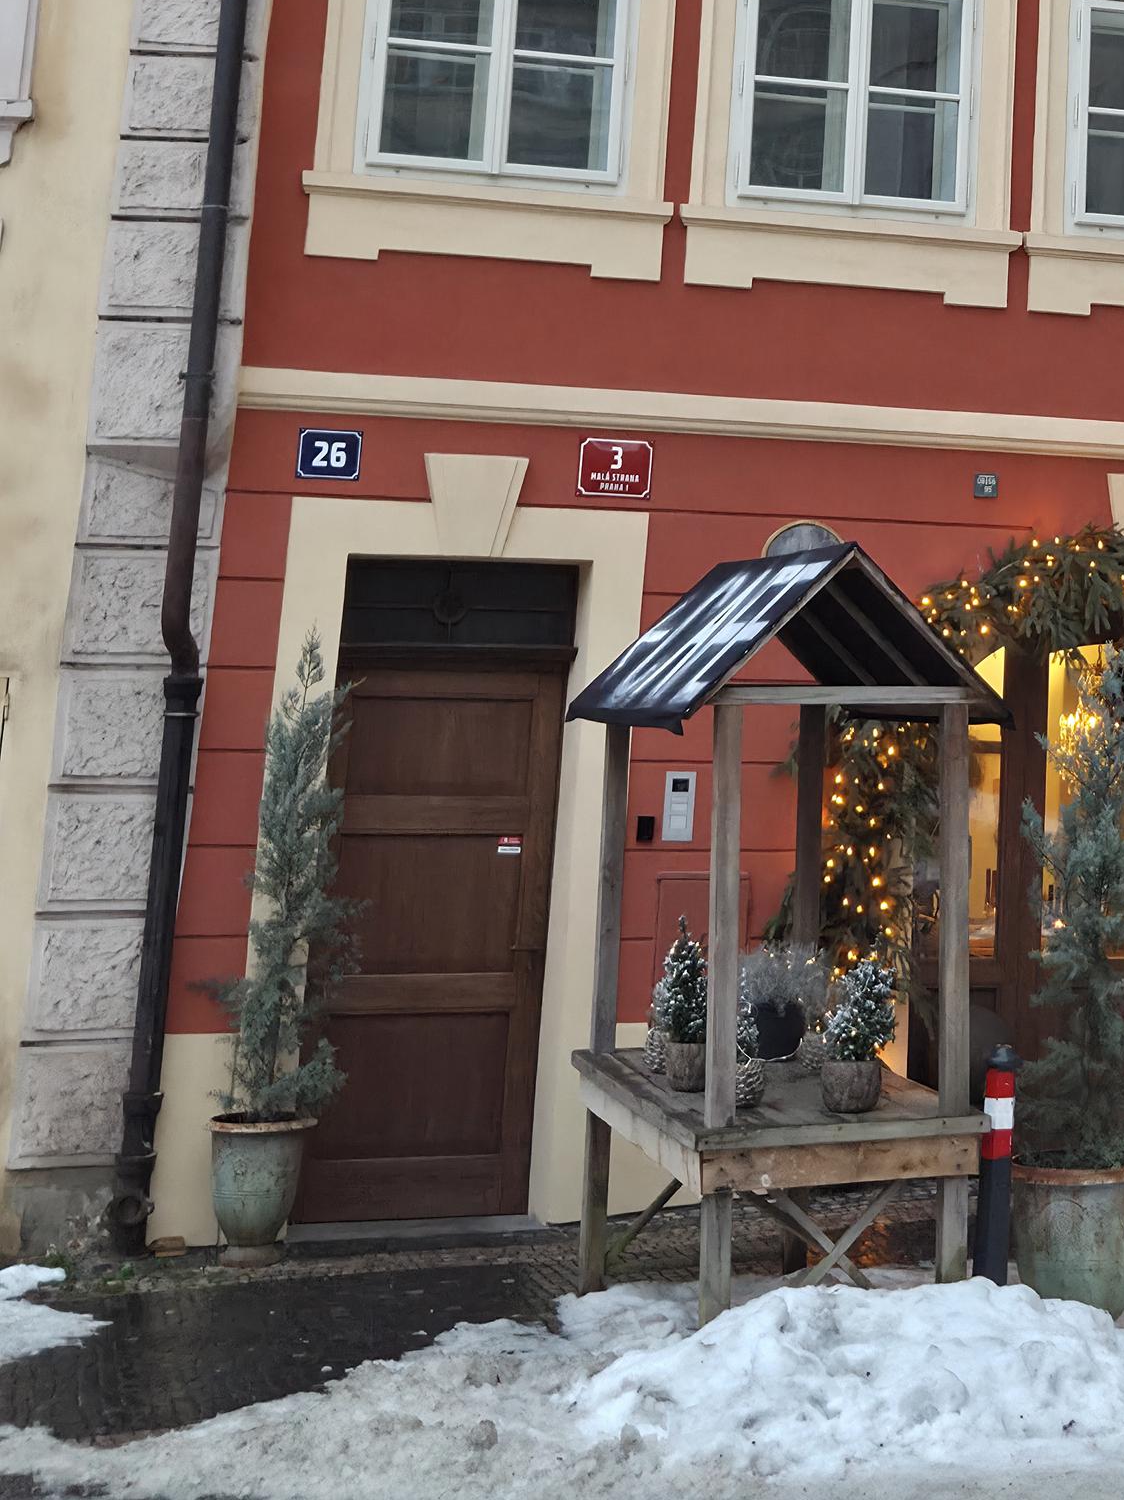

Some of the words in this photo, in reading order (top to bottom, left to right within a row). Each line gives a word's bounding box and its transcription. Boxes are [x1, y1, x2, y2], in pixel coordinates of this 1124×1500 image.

[311, 440, 348, 469] 26
[610, 446, 624, 470] 3
[590, 471, 610, 481] MALÁ
[612, 473, 640, 483] STRANA
[600, 482, 624, 492] PRAHA
[626, 484, 630, 492] 1
